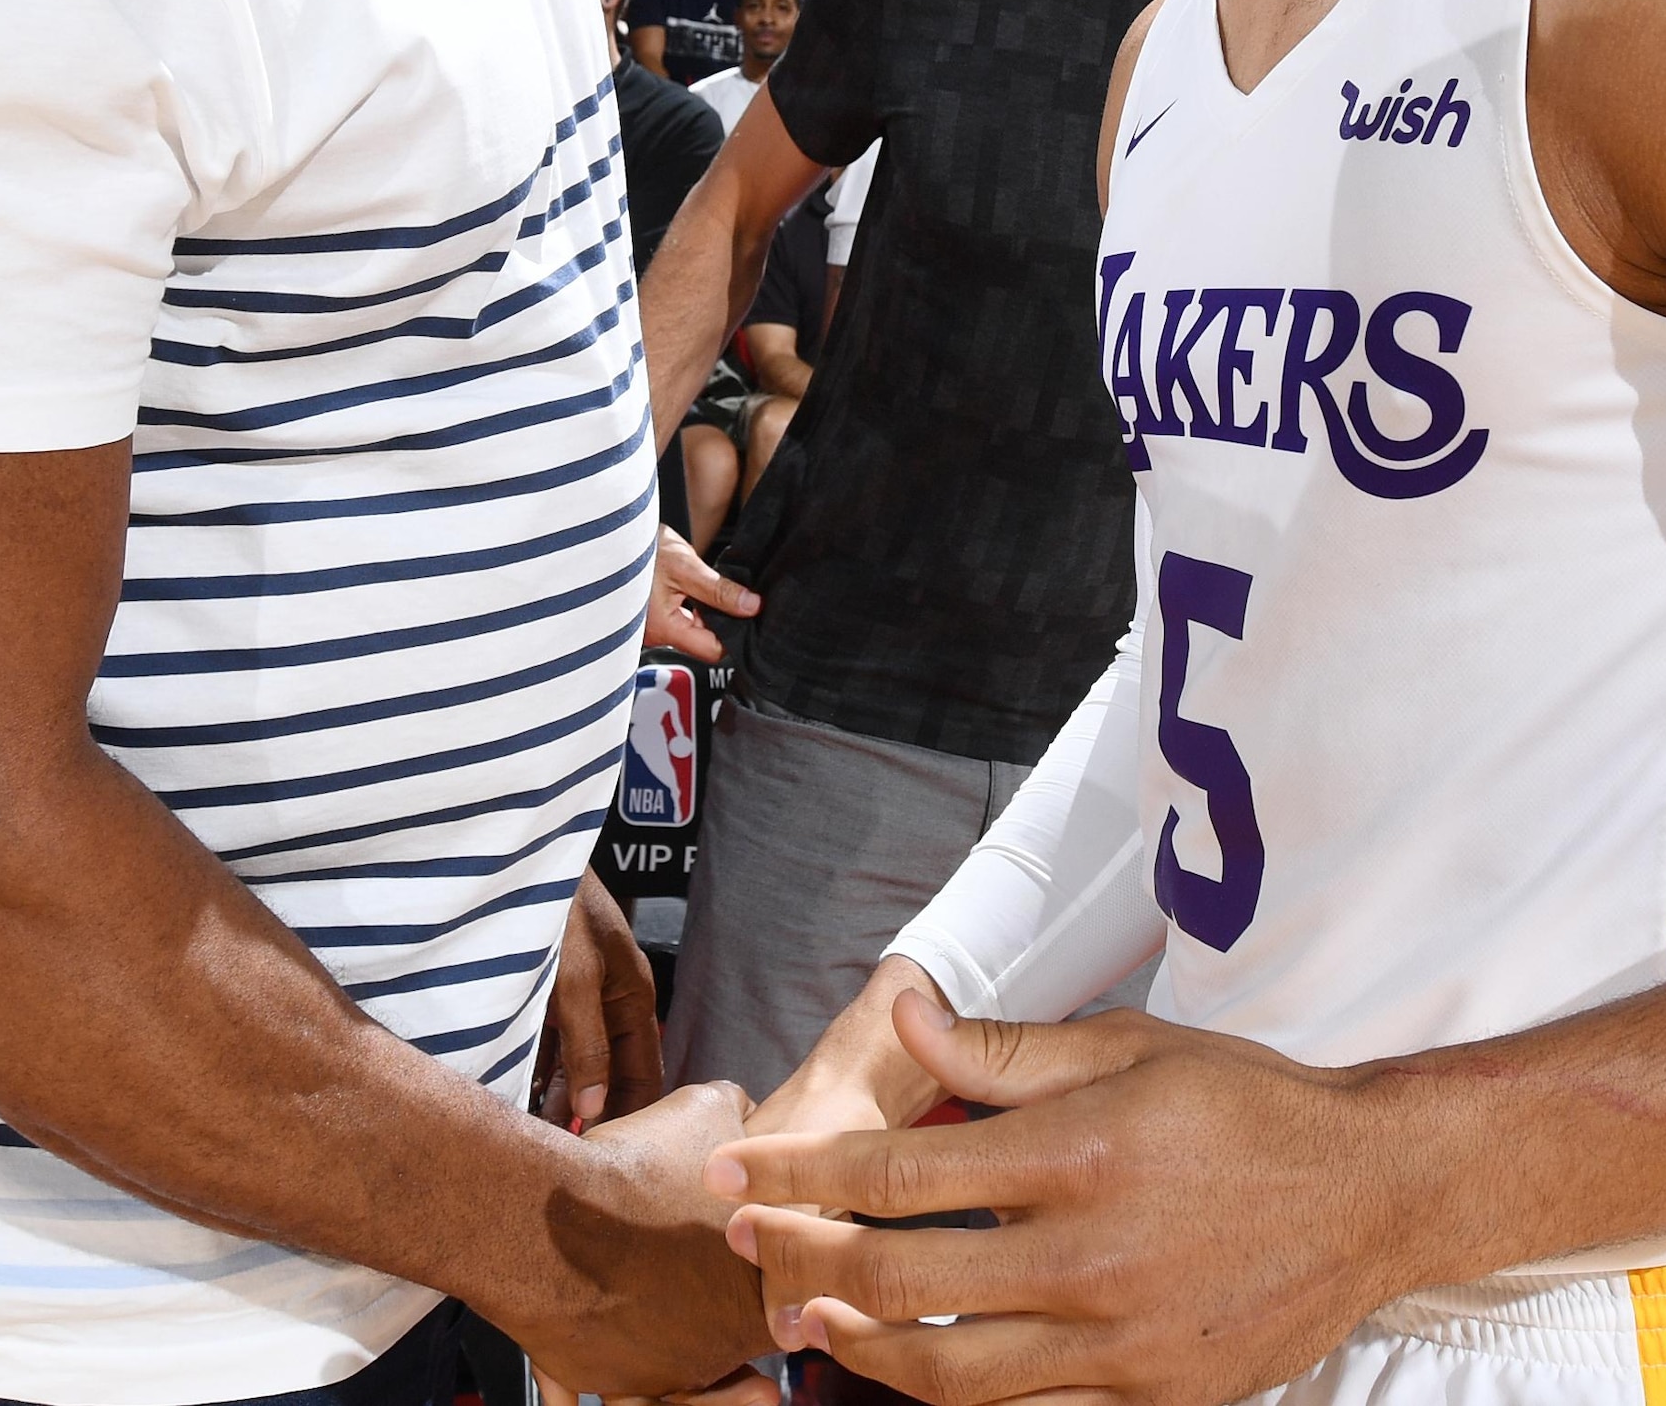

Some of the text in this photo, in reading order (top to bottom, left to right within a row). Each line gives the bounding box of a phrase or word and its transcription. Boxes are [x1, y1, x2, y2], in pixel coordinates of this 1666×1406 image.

[1339, 78, 1471, 148] wish
[1097, 250, 1490, 500] LAKERS
[1153, 550, 1266, 954] 5
[629, 788, 665, 815] NBA
[612, 843, 673, 873] VIP
